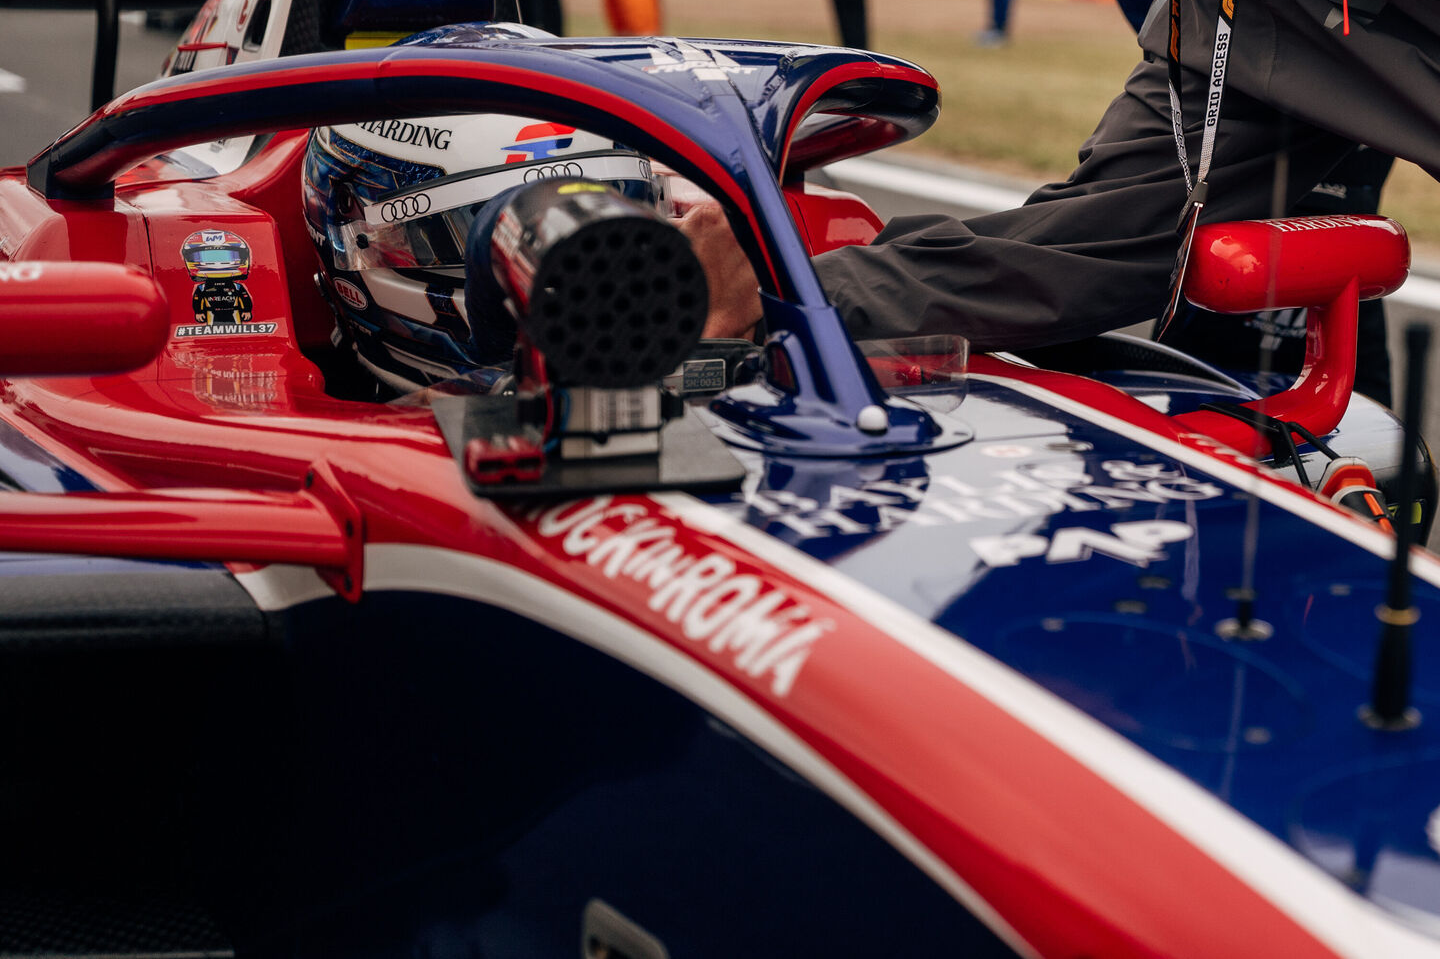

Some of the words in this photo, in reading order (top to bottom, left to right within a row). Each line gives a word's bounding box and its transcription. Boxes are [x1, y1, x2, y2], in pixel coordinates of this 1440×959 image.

[1212, 32, 1229, 86] ACCESS
[1207, 97, 1221, 127] GRID
[337, 282, 365, 306] BELL
[178, 324, 275, 336] #TEAMWILL37
